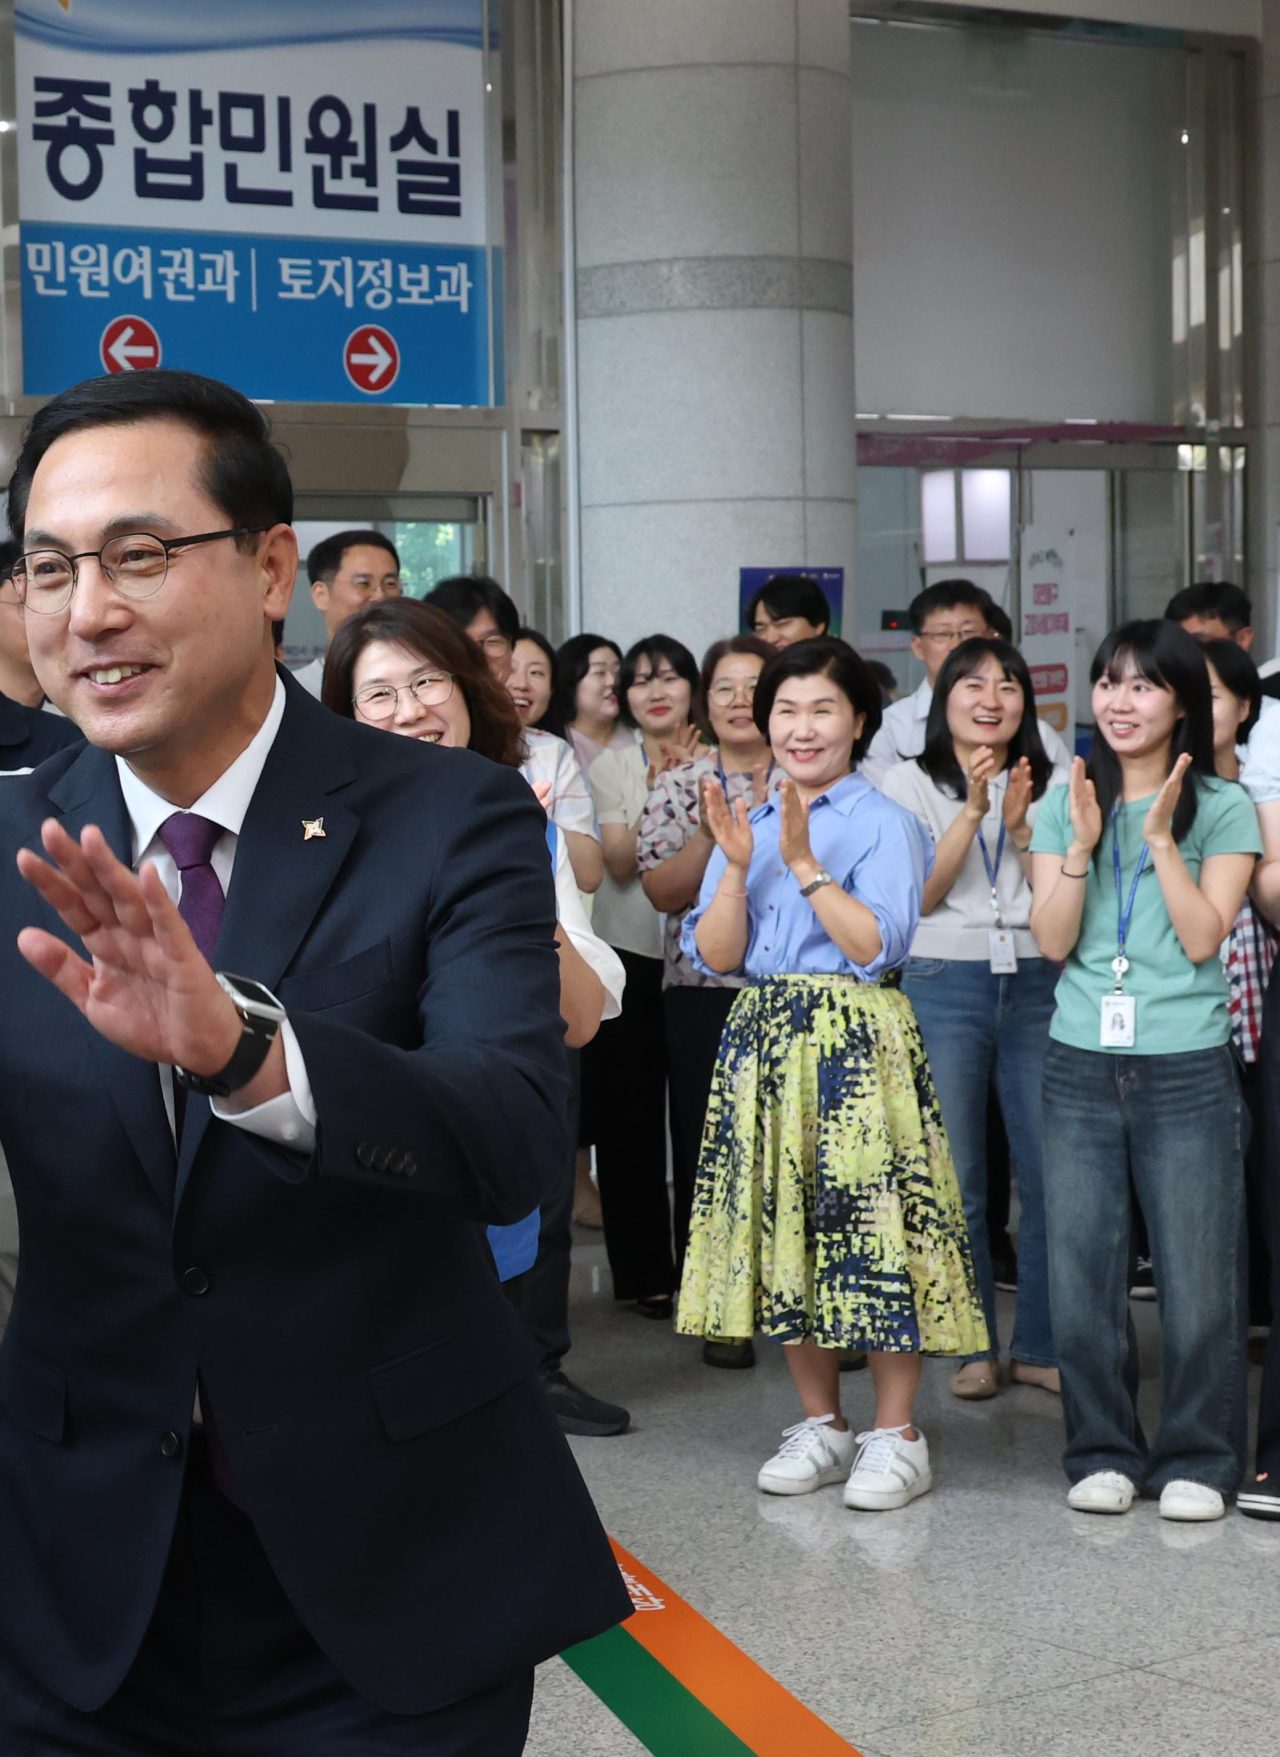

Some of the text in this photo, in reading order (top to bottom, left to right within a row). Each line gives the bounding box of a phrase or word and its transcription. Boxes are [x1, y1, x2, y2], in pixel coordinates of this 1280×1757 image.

[33, 77, 462, 217] 종합민원실
[26, 241, 473, 313] 민원여권과 토지정보과
